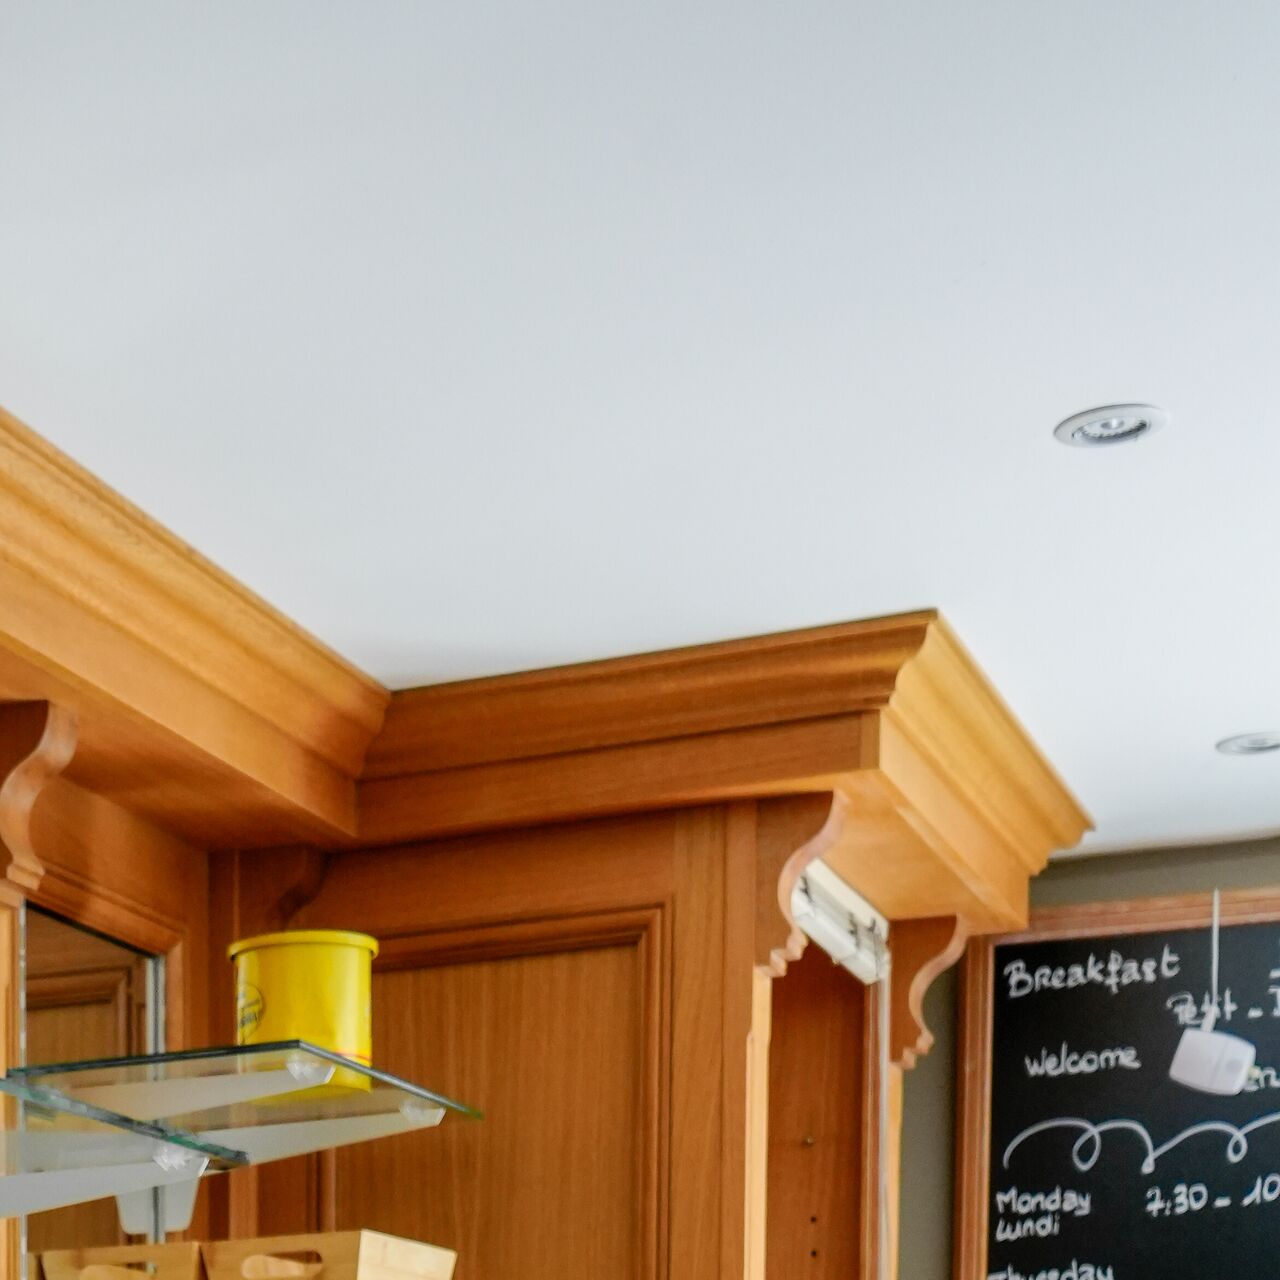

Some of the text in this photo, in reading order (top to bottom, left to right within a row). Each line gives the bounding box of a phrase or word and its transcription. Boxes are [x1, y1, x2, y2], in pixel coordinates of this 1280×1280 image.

[1003, 944, 1181, 998] Breakfast
[995, 1185, 1091, 1217] Monday
[1145, 1182, 1208, 1218] 7:30
